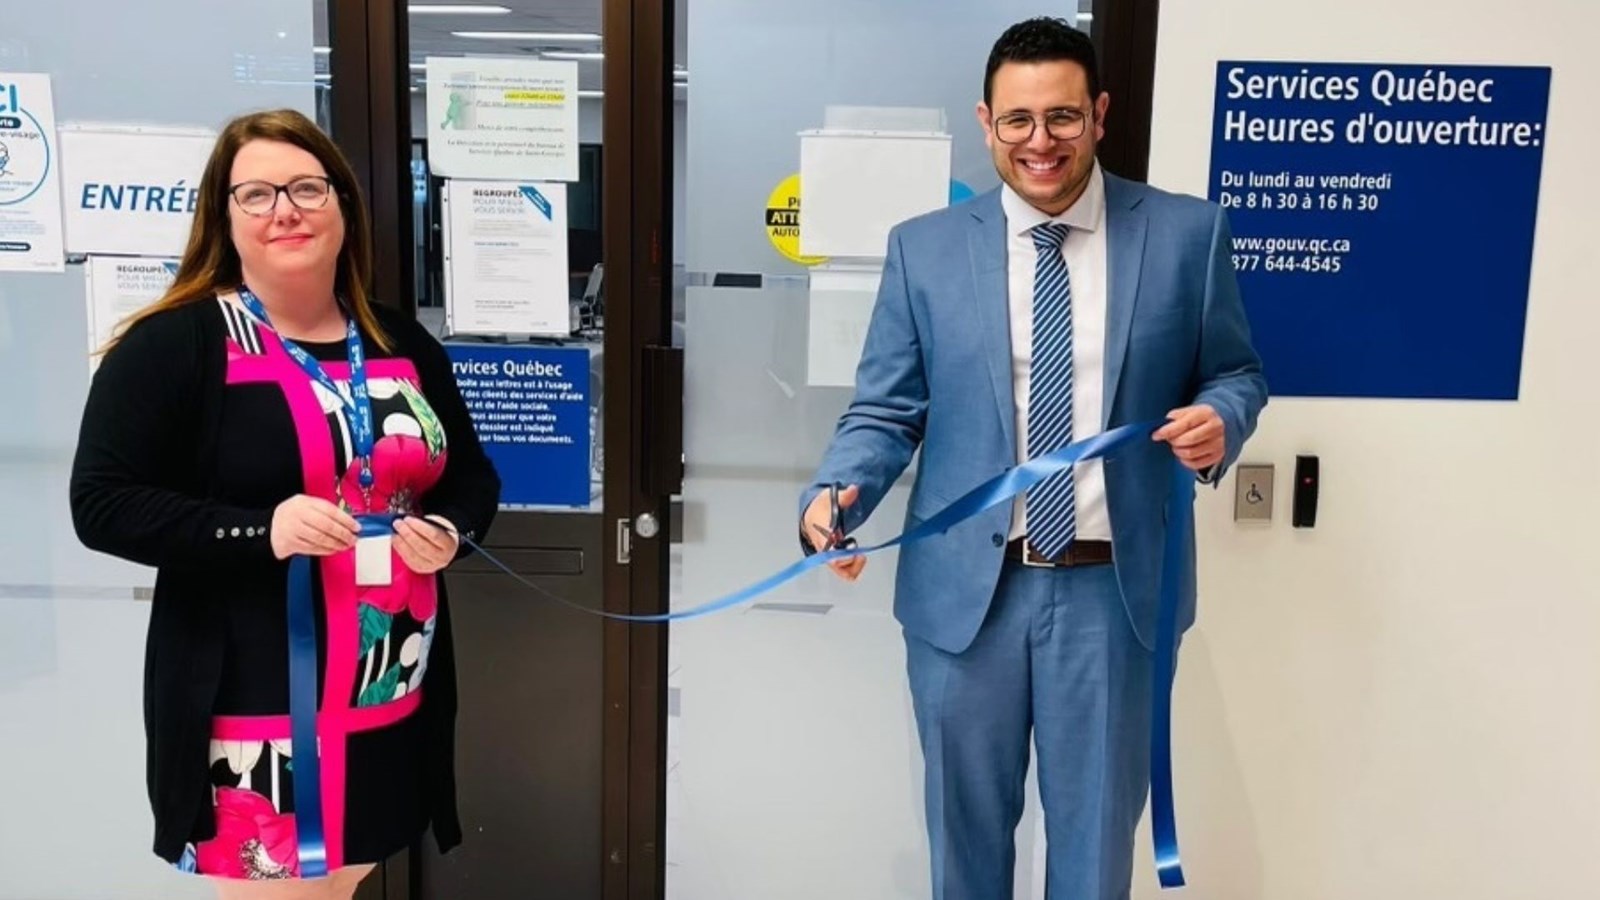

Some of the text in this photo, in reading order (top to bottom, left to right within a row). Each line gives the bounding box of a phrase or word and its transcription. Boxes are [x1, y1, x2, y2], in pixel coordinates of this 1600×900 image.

[1227, 67, 1493, 105] Services Québec
[1224, 110, 1541, 146] Heures d'ouverture:
[1221, 170, 1392, 189] Du lundi au vendredi
[1220, 192, 1378, 210] De 8 h 30 à 16 h 30
[1265, 255, 1341, 272] 644-4545
[503, 360, 562, 378] Québec
[495, 379, 521, 388] lettres
[523, 380, 535, 388] est
[537, 380, 543, 388] à
[545, 381, 573, 391] l'usage
[465, 389, 480, 398] des
[482, 390, 508, 399] clients
[510, 390, 523, 399] des
[526, 391, 558, 400] services
[559, 392, 583, 401] d'aide
[475, 401, 483, 409] et
[485, 401, 495, 409] de
[497, 401, 519, 410] l'aide
[519, 413, 534, 422] que
[536, 414, 557, 422] votre
[479, 423, 508, 431] dossier
[510, 423, 521, 431] est
[524, 423, 554, 434] indiqué
[493, 434, 511, 442] tous
